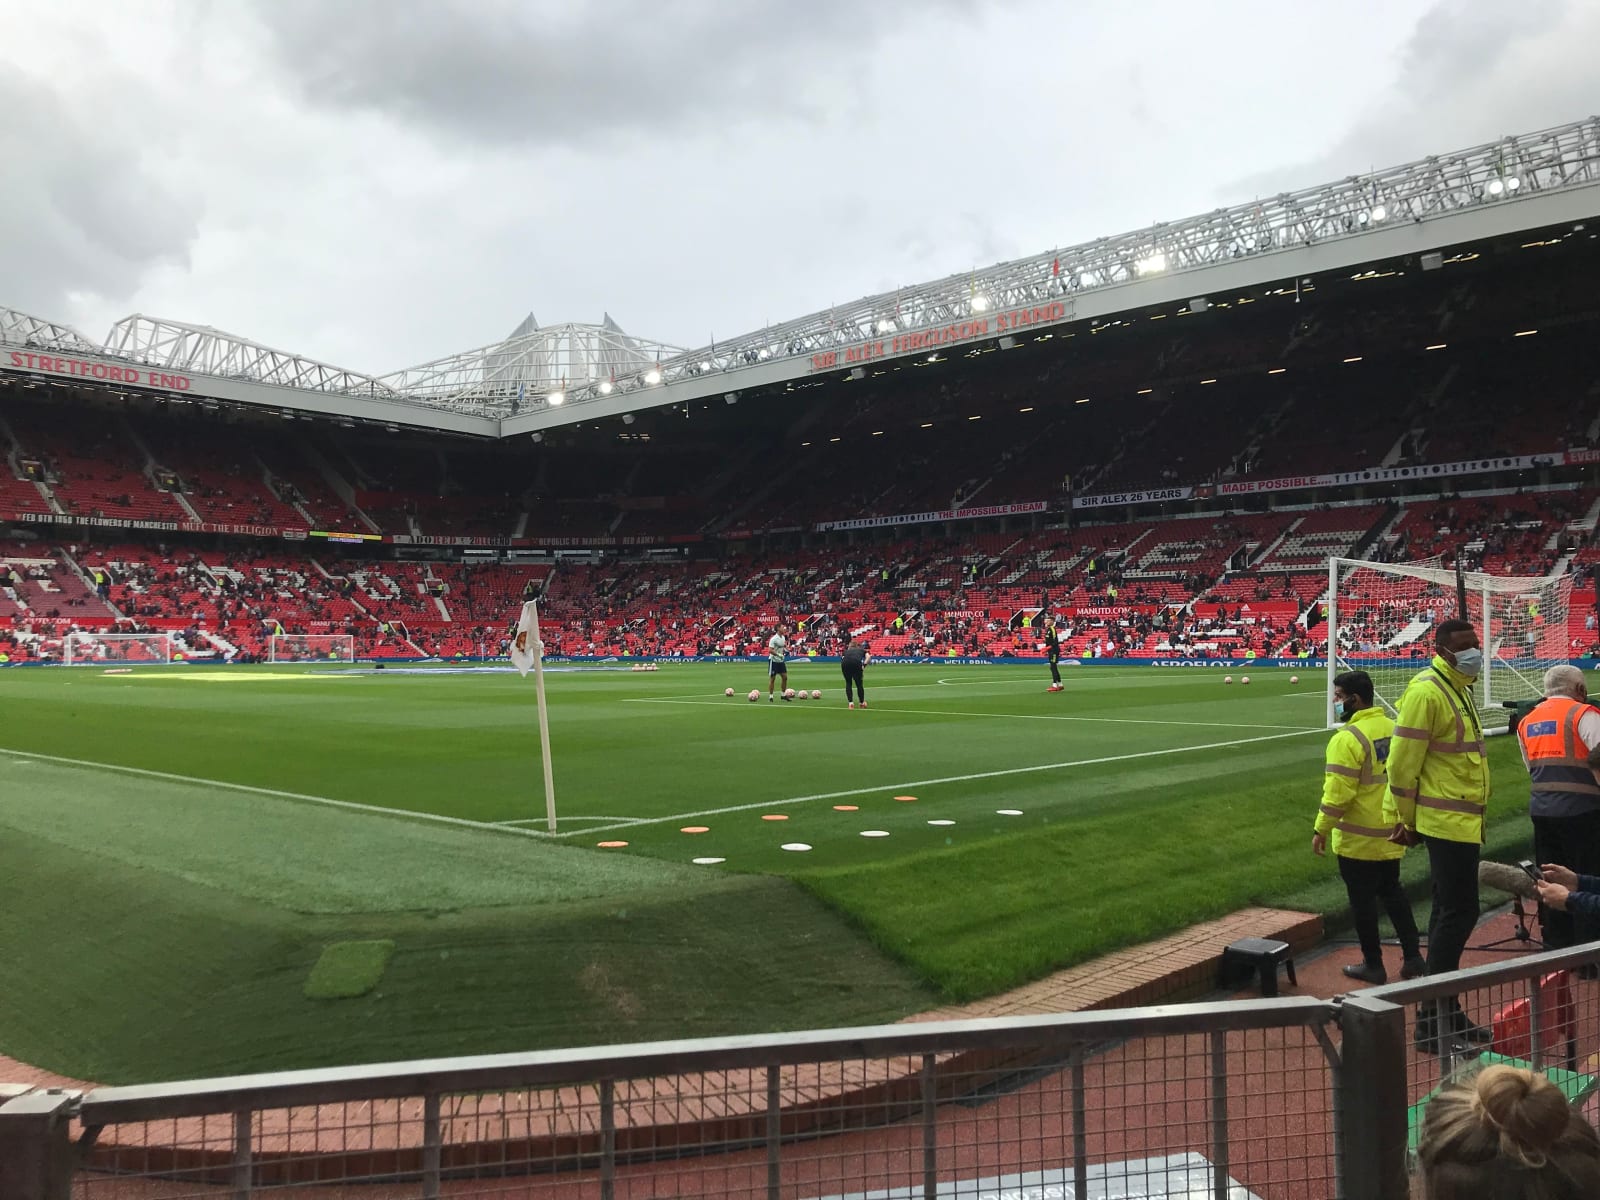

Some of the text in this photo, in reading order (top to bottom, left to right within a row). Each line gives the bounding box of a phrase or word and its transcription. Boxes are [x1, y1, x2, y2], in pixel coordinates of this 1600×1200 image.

[813, 302, 1065, 370] SIR ALEX FERGUSON STAND
[10, 351, 190, 391] STRETFORD END
[1222, 483, 1254, 494] MADE
[1081, 489, 1182, 506] SIR ALEX 26 YEARS
[938, 502, 1043, 520] THE IMPOSSIBLE DREAM
[76, 516, 89, 525] THE
[90, 516, 122, 527] FLOWERS
[123, 519, 131, 528] OF
[133, 520, 178, 531] MANCHESTER
[182, 522, 208, 532] MUFC
[212, 523, 231, 533] THE
[233, 525, 278, 536] RELIGION
[636, 536, 655, 545] ARMY
